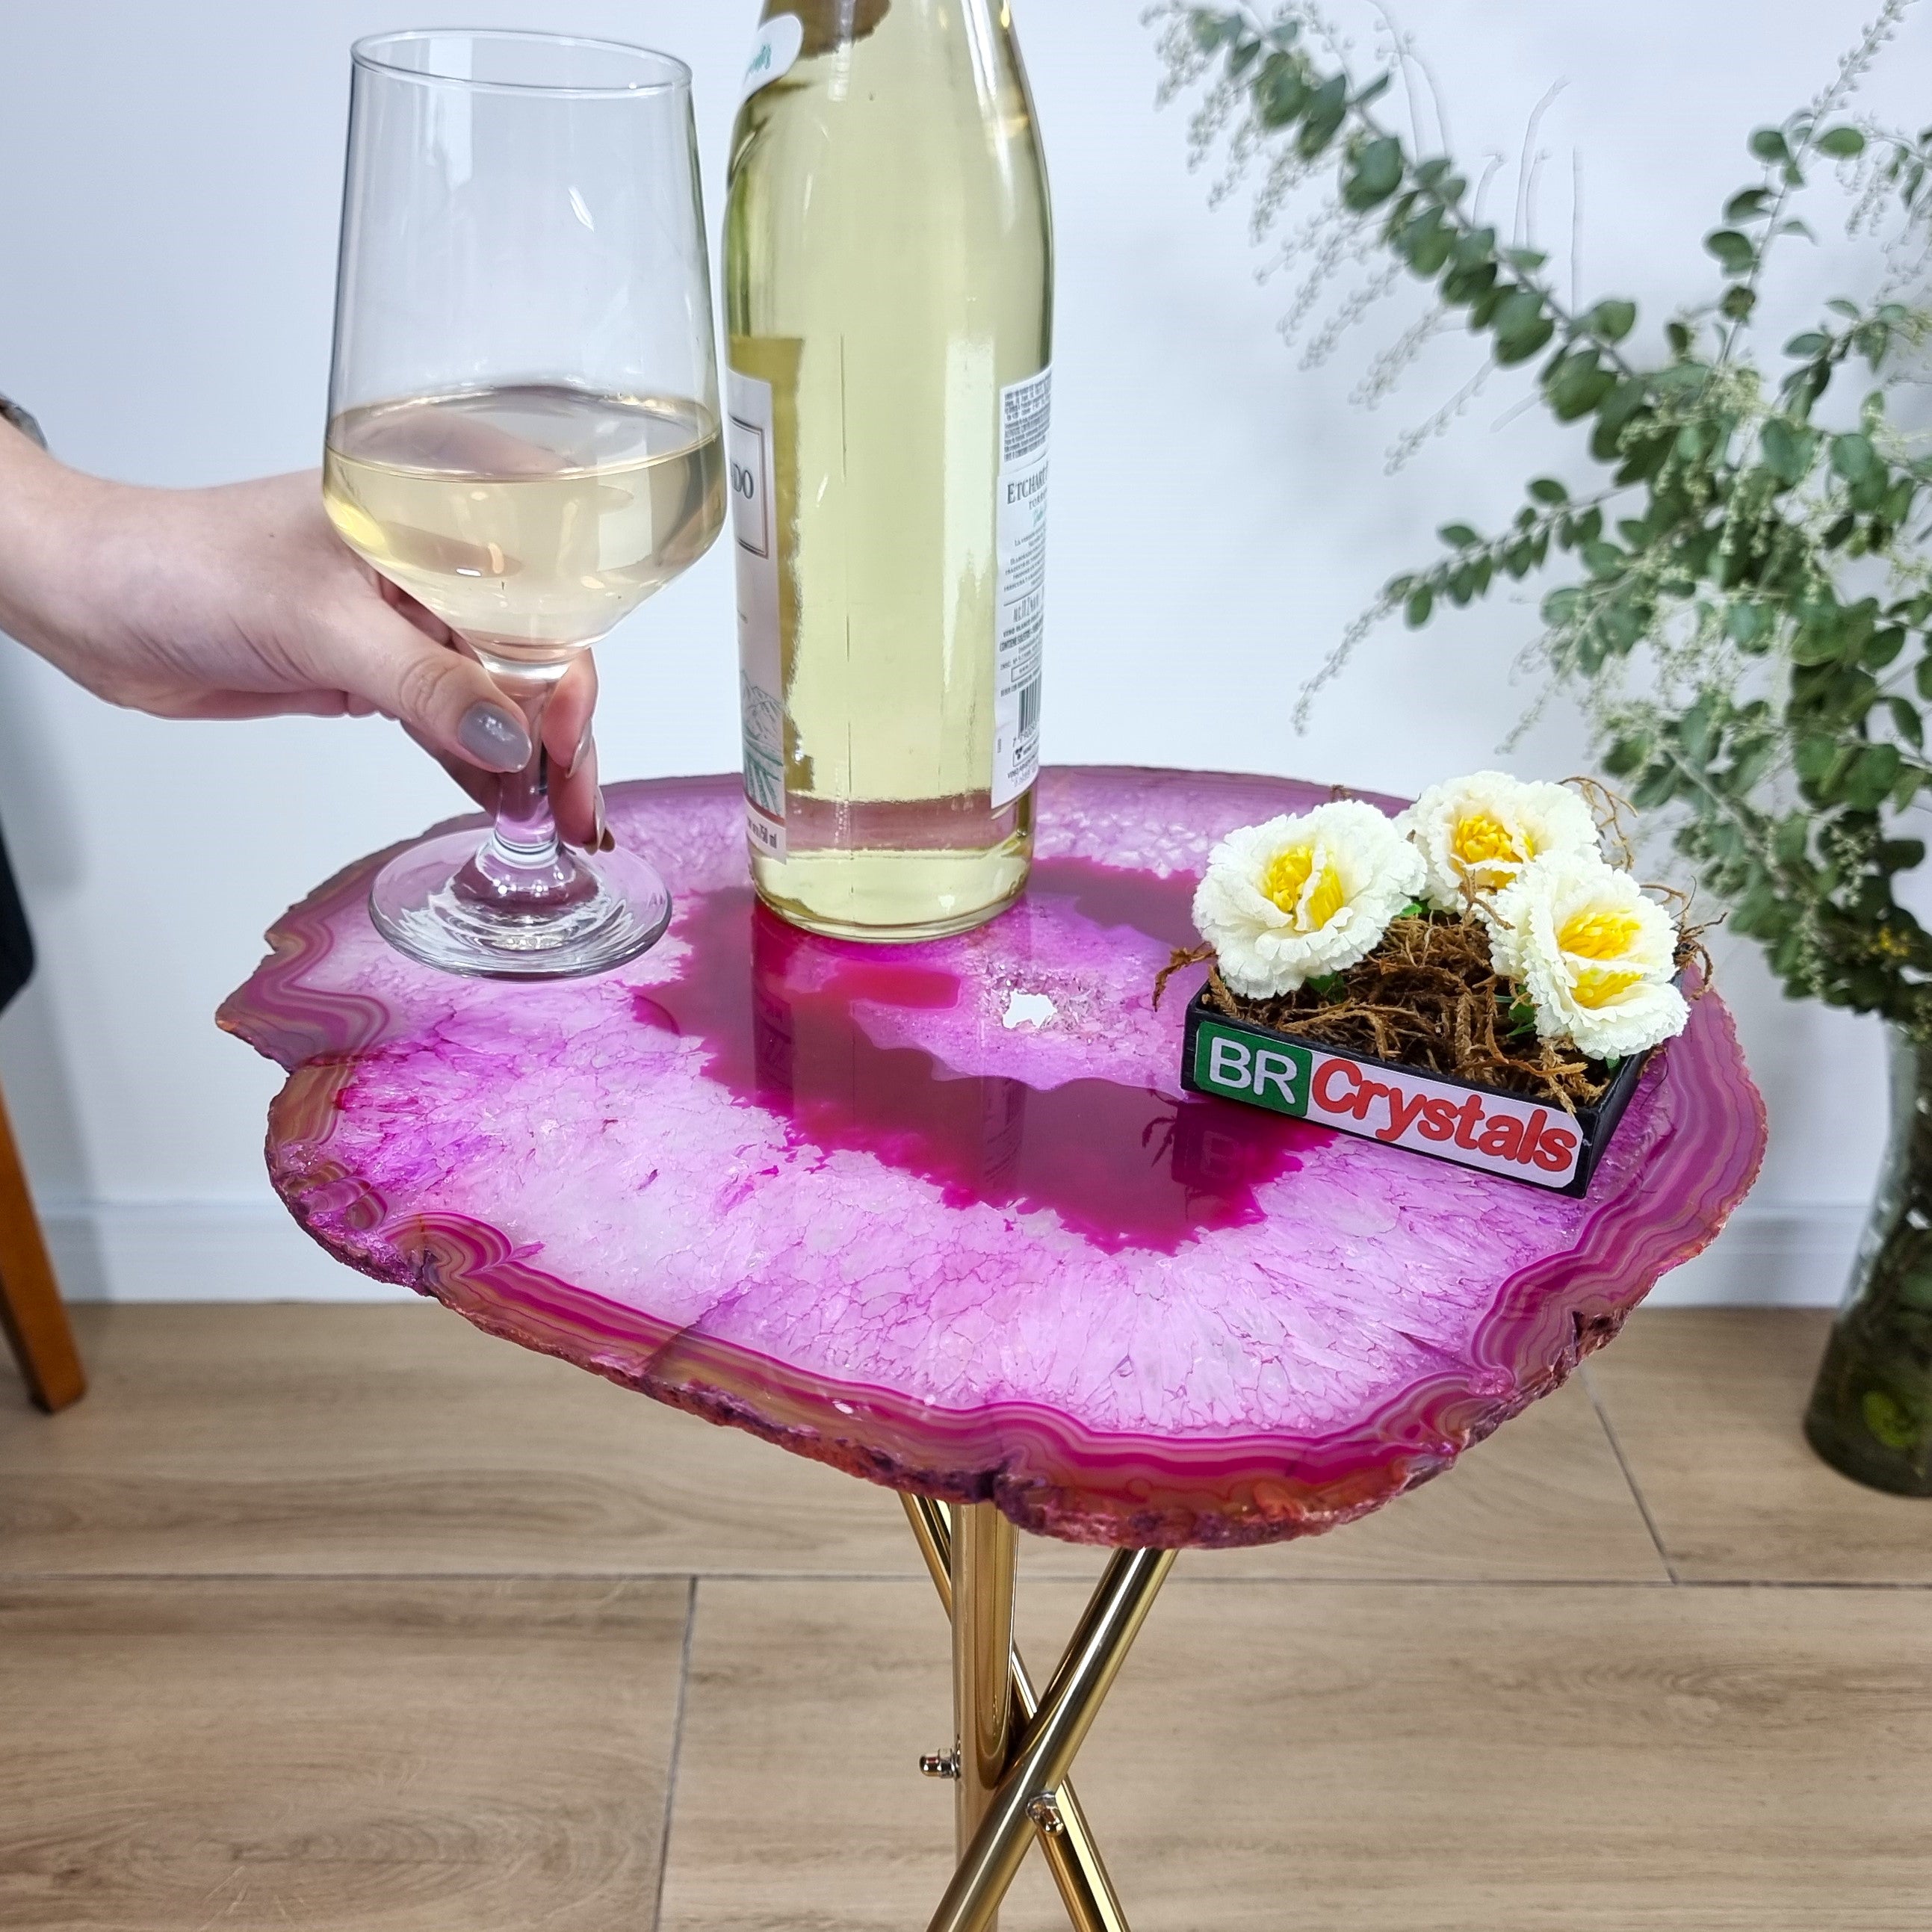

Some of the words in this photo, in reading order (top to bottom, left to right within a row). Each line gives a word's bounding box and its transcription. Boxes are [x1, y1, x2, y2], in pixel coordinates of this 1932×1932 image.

[731, 462, 754, 500] DO
[1209, 1035, 1298, 1104] BR
[1311, 1058, 1578, 1173] Crystals
